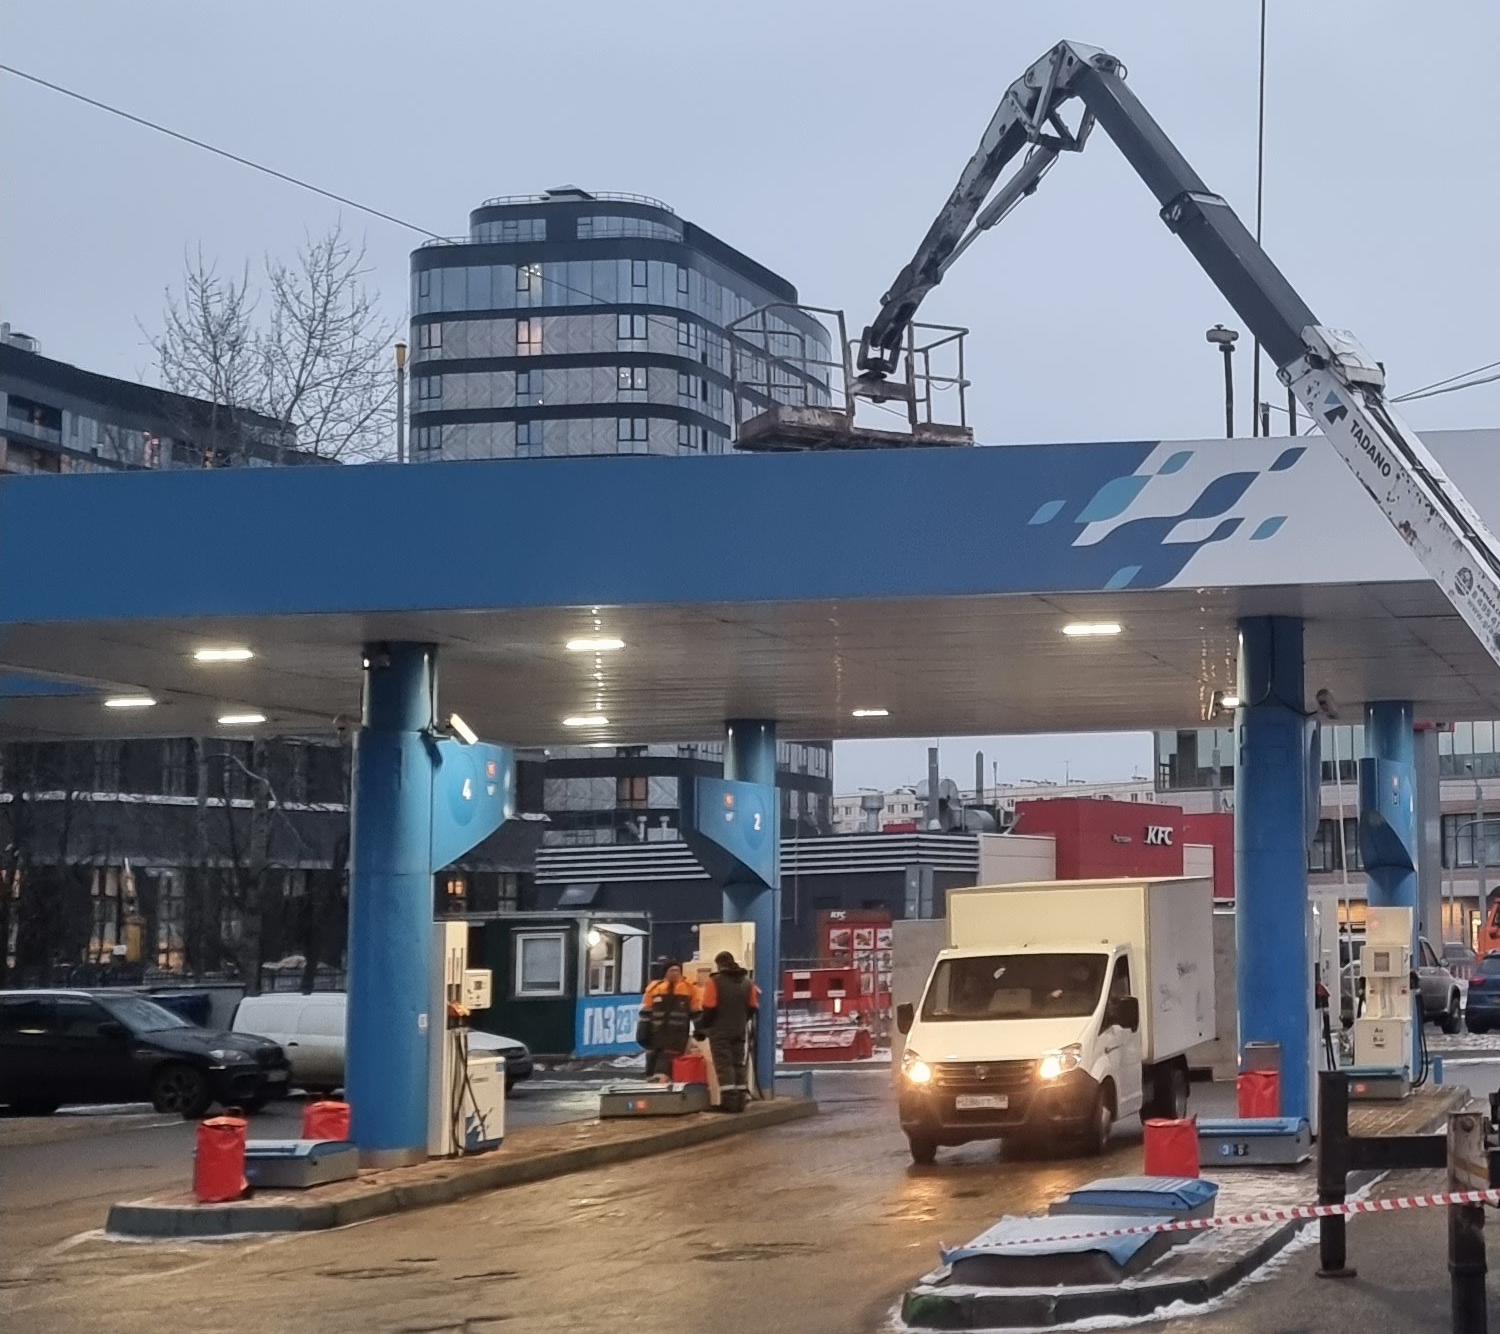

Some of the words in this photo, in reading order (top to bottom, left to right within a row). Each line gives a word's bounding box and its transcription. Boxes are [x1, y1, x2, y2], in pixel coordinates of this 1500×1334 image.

[1350, 419, 1391, 477] TADANO
[462, 778, 472, 800] 4
[753, 812, 761, 831] 2
[1143, 825, 1174, 846] KFC
[583, 1006, 616, 1046] ГАЗ
